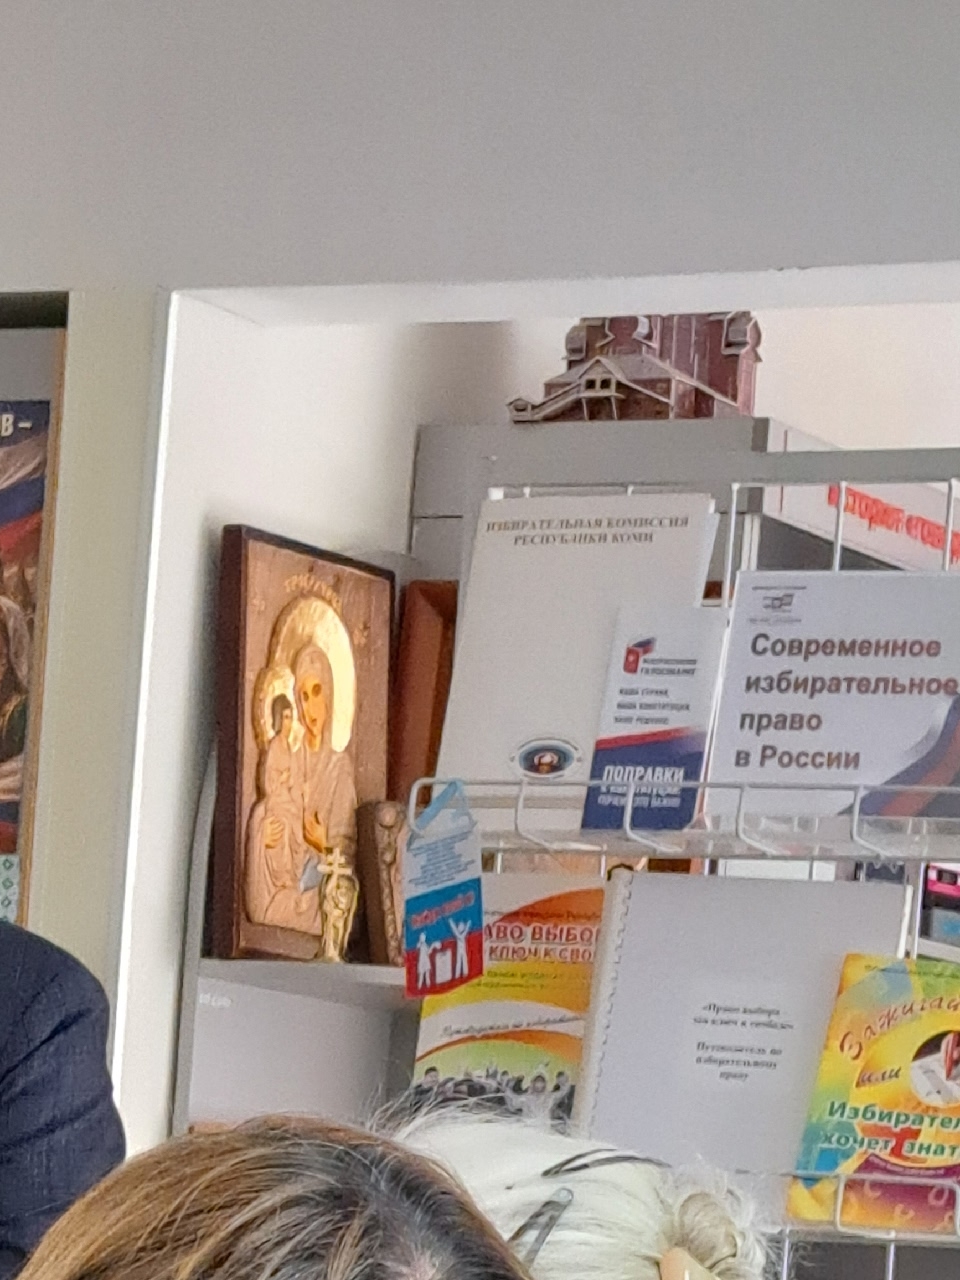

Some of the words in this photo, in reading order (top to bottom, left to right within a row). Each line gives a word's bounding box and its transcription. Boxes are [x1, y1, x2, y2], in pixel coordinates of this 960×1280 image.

[486, 517, 602, 532] ИЗБИРАТЕЛЬНАЯ
[607, 516, 689, 529] КОМИССИЯ
[513, 532, 607, 546] РЕСПУБЛИКИ
[611, 532, 654, 543] КОМИ
[750, 633, 942, 662] Современное
[744, 669, 959, 699] избирательное
[739, 712, 823, 736] право
[734, 750, 751, 768] в
[759, 744, 861, 770] России
[602, 765, 684, 783] ПОПРАВКИ
[489, 945, 538, 960] КЛЮЧ
[860, 1066, 902, 1084] или
[821, 1132, 891, 1150] хочет
